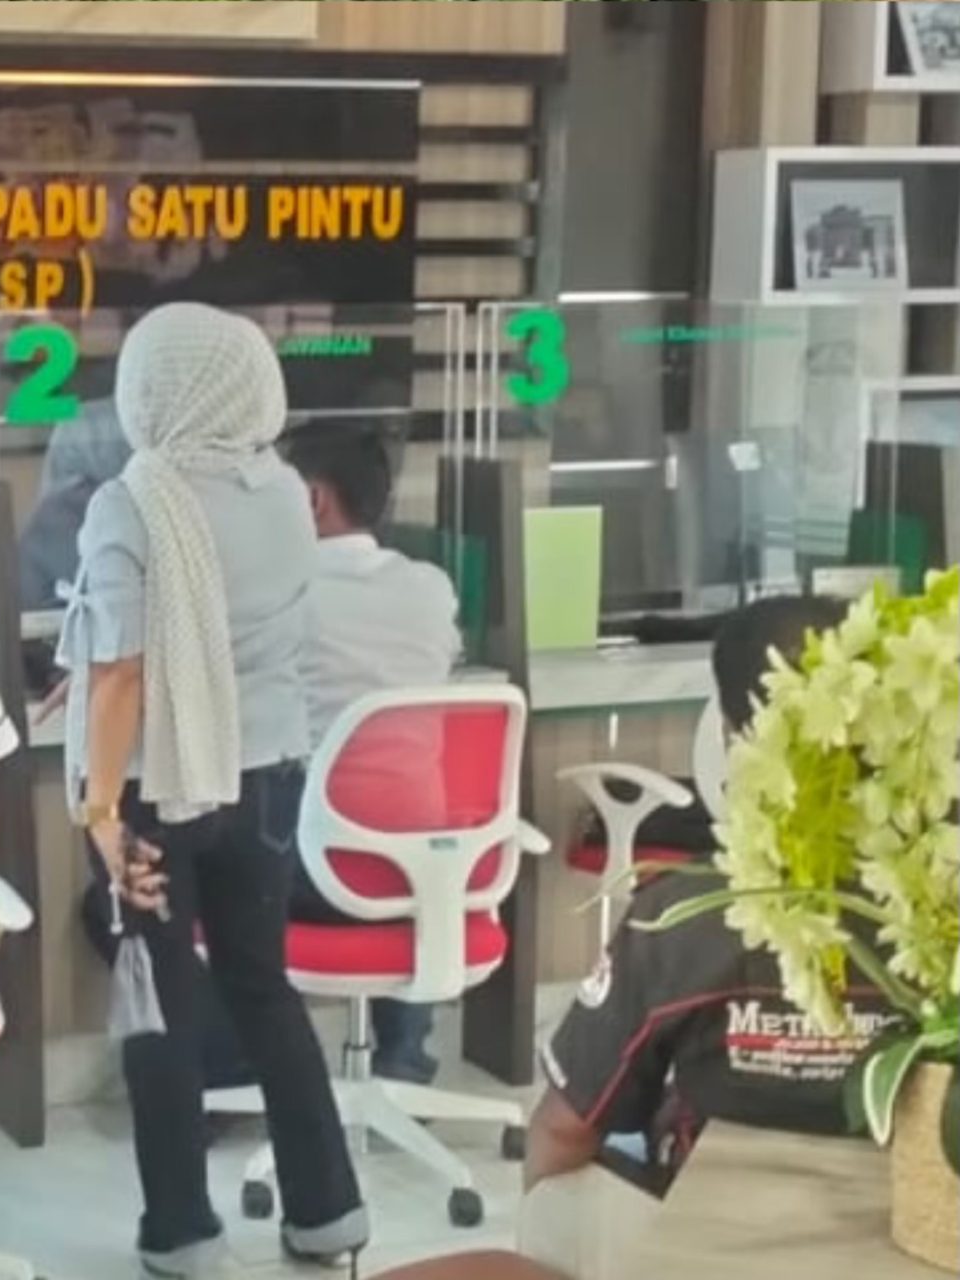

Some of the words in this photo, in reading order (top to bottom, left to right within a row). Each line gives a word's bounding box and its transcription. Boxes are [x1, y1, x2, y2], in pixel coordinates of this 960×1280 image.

[128, 183, 247, 240] SATU
[268, 185, 403, 240] PINTU
[5, 323, 81, 424] 2
[506, 306, 570, 406] 3
